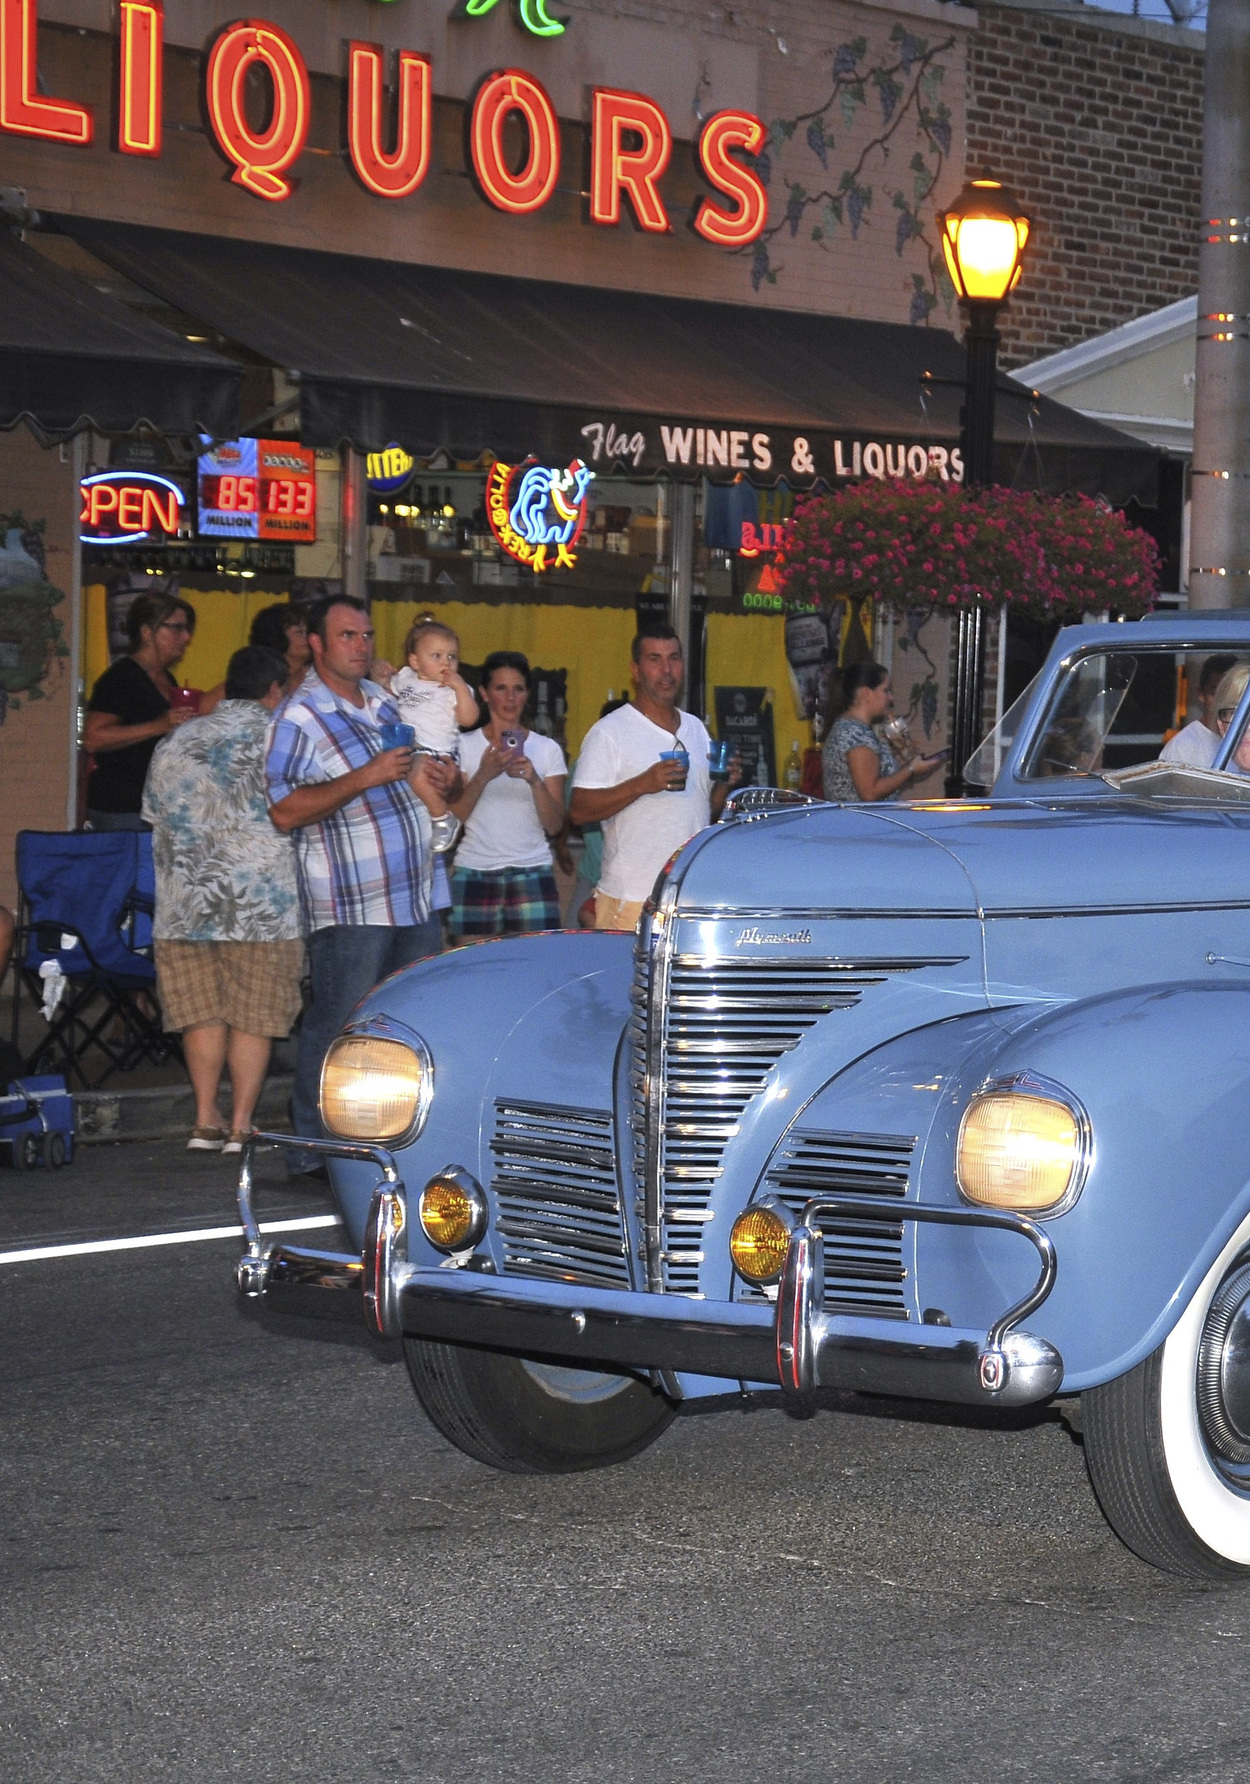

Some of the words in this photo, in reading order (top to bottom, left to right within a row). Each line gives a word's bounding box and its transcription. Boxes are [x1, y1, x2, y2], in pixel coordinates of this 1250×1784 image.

[0, 0, 769, 247] LIQUORS
[581, 422, 646, 467] Flag
[661, 424, 772, 471] WINES
[791, 436, 814, 474] &
[834, 440, 965, 482] LIQUORS
[80, 484, 178, 534] PEN
[218, 475, 257, 511] 85
[268, 480, 314, 516] 133
[205, 514, 252, 528] MILLION
[264, 518, 310, 531] MILLION
[735, 926, 812, 948] Plymouth
